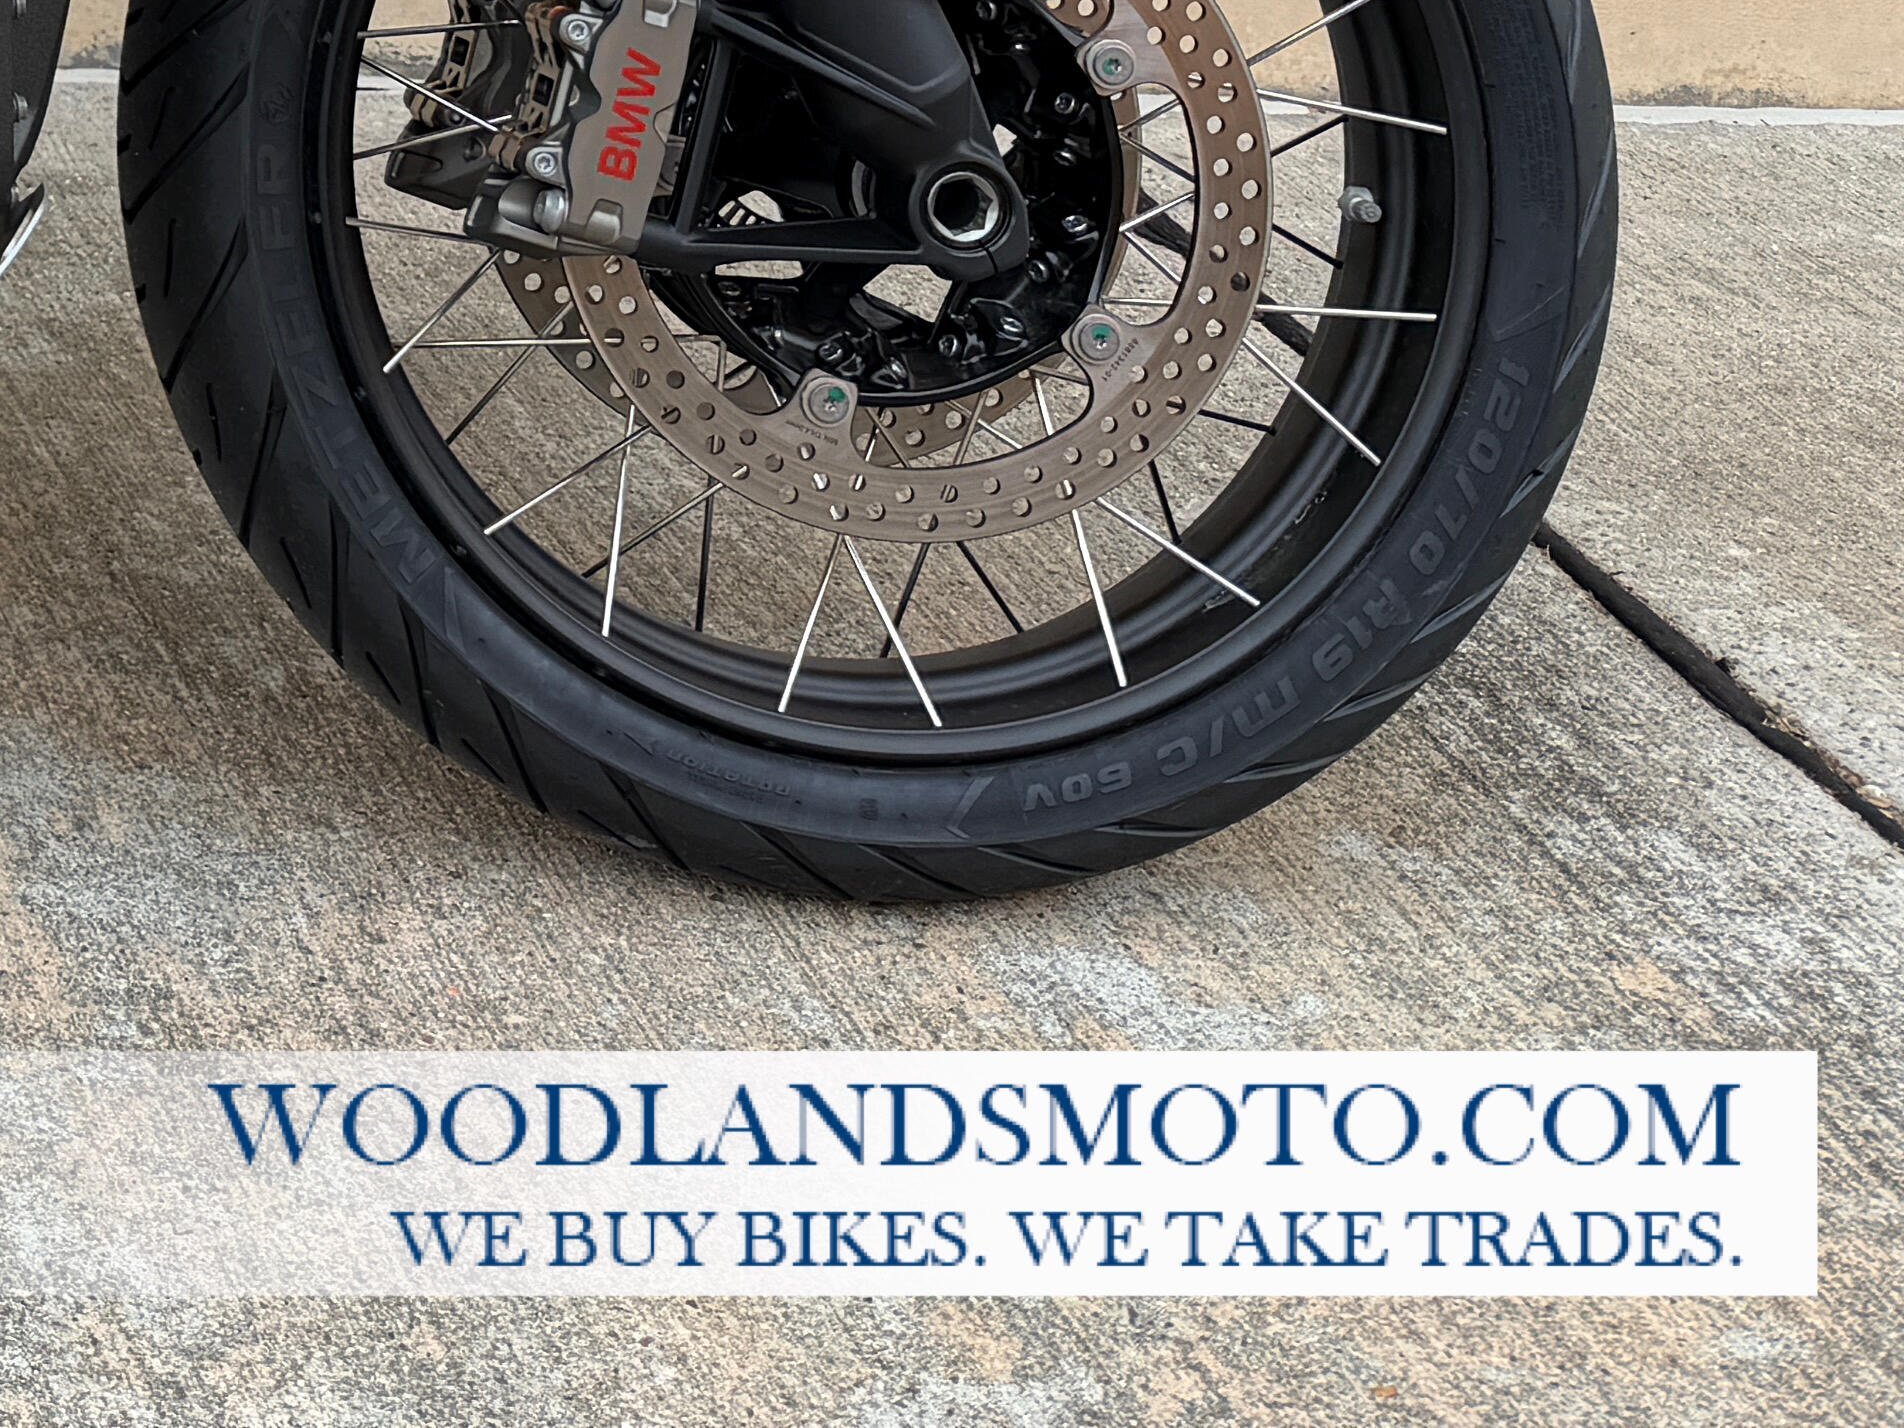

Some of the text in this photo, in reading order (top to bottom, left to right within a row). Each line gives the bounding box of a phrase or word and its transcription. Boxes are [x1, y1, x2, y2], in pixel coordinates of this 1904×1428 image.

[597, 47, 663, 181] BMW
[256, 146, 438, 582] METZELER
[1408, 359, 1531, 576] 120/70
[1310, 576, 1414, 682] R19
